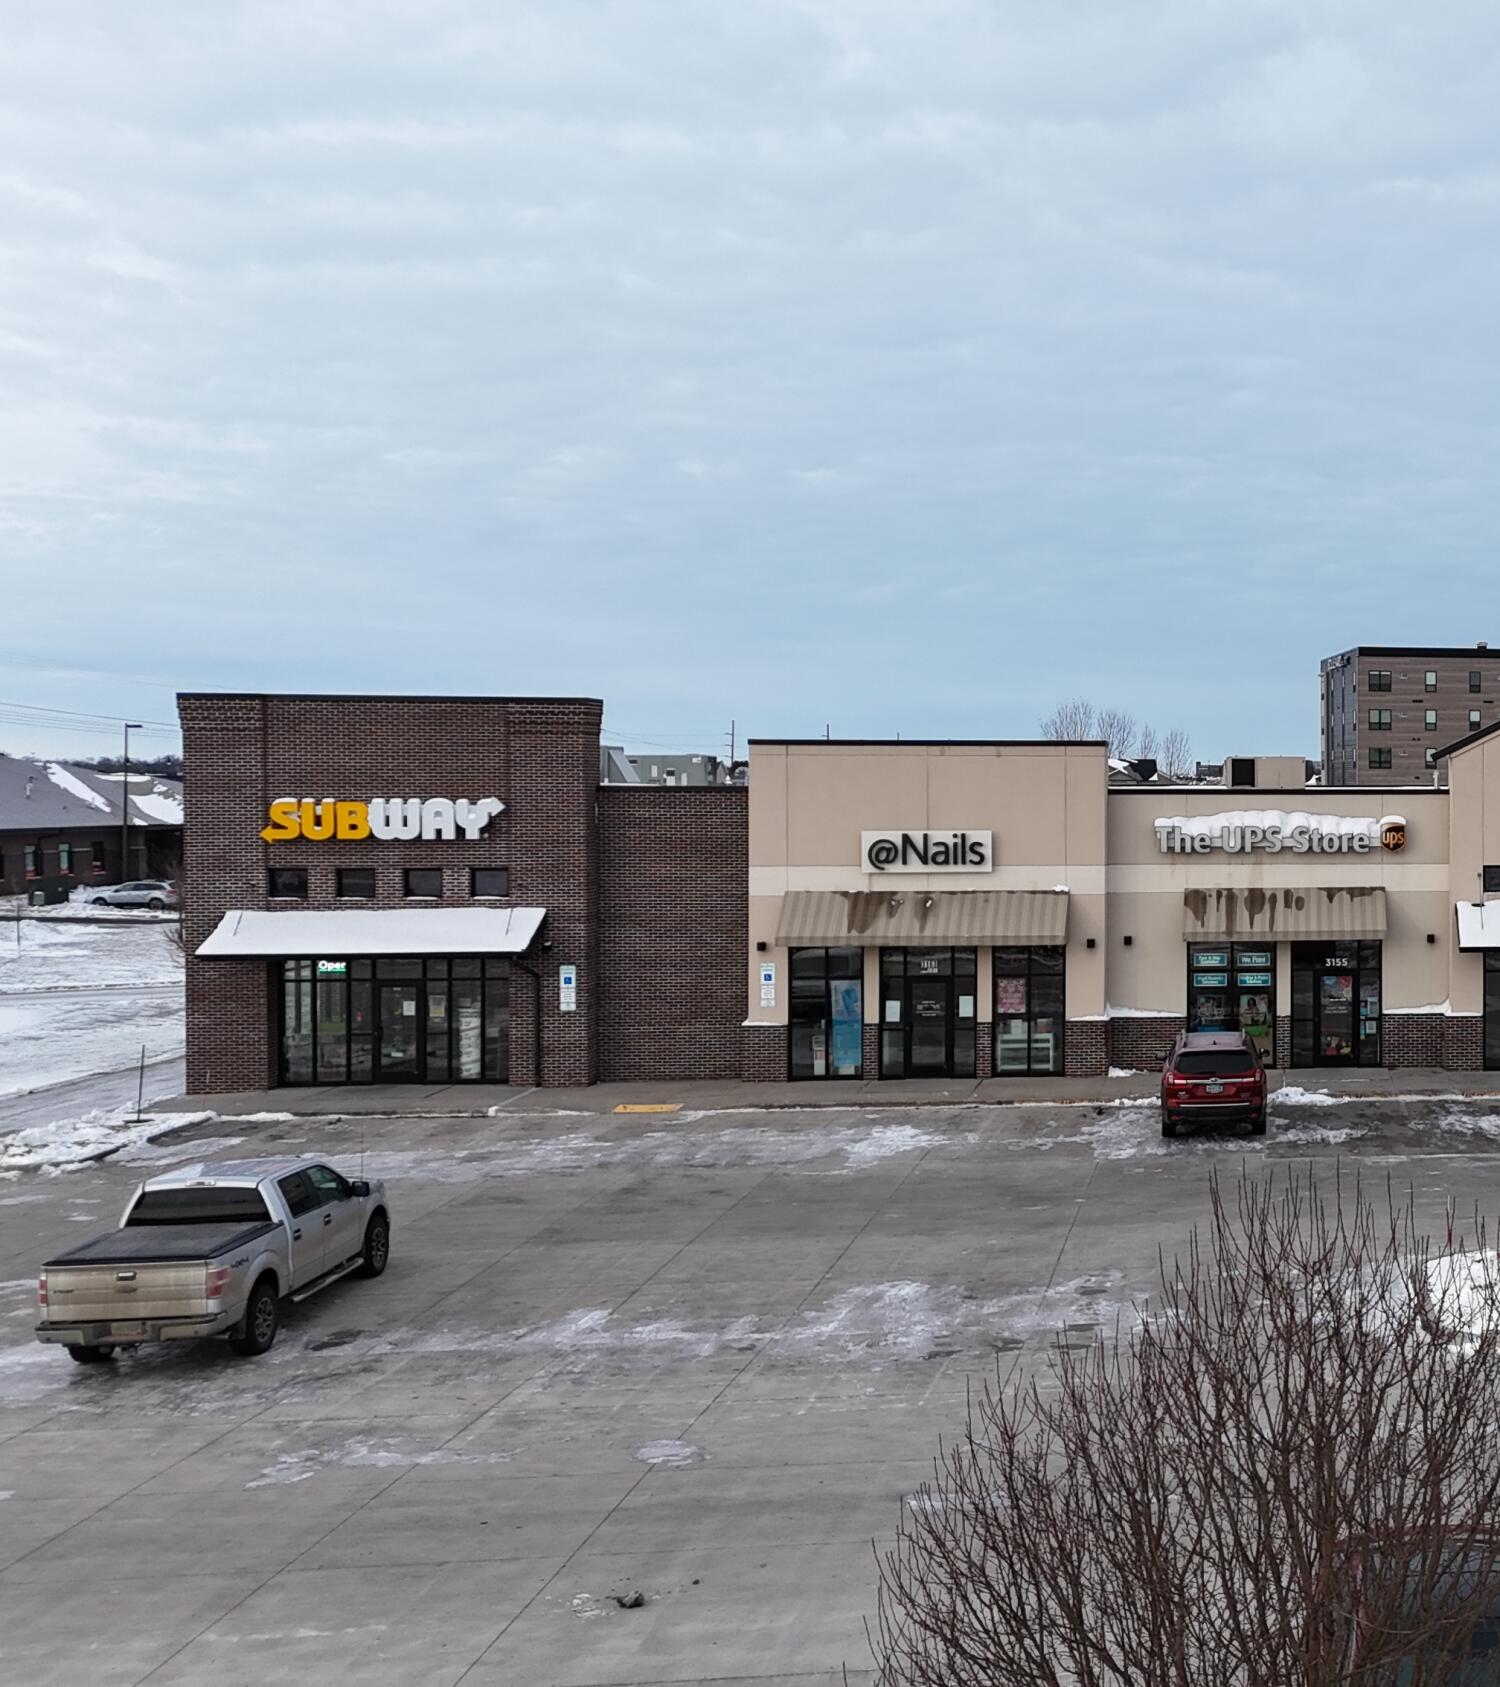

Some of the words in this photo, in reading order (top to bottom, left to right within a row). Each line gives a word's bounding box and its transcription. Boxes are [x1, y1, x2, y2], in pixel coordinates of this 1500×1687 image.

[260, 797, 506, 843] SUBWAY
[867, 833, 986, 871] @Nails
[1155, 825, 1212, 854] The
[1221, 825, 1283, 854] UPS
[1292, 825, 1370, 854] Store
[1325, 958, 1348, 967] 3155
